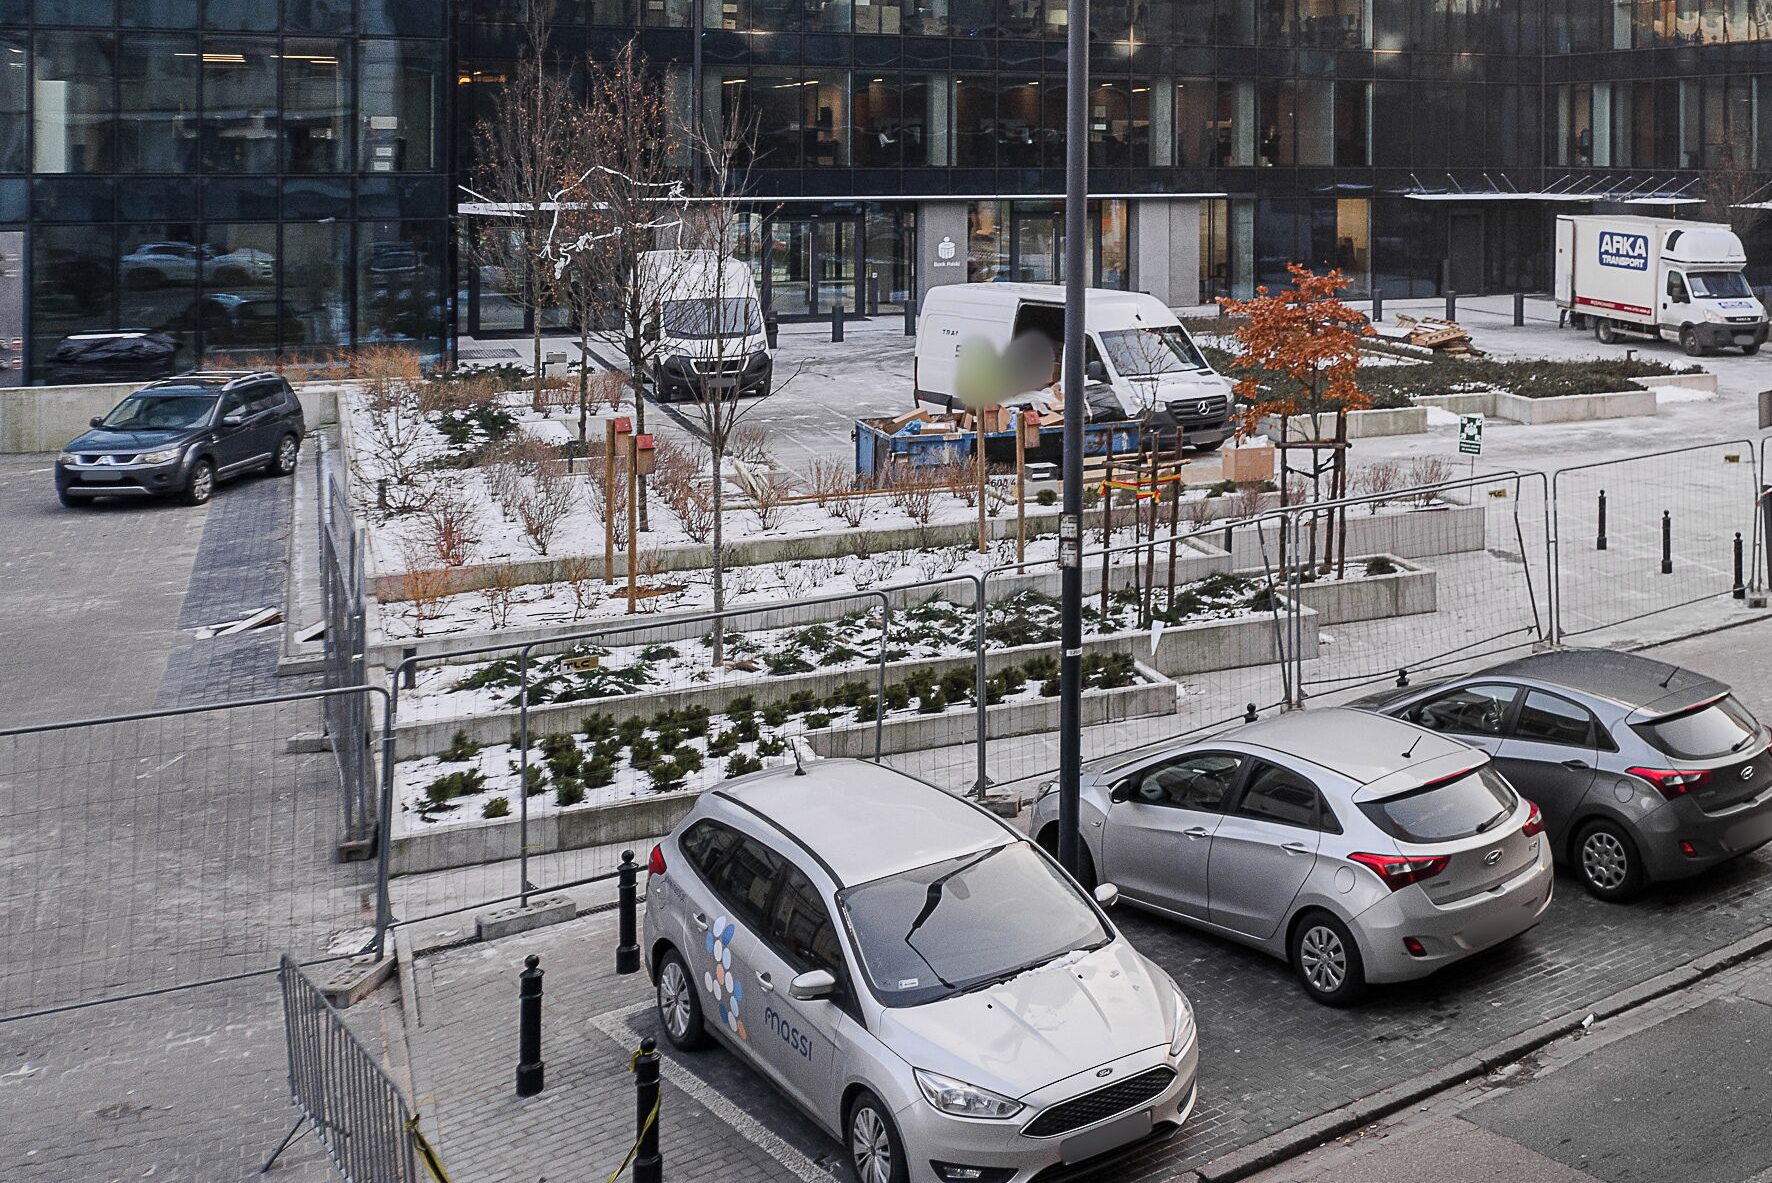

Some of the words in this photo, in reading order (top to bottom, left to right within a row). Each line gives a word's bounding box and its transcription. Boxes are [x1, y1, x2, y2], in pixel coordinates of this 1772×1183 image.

[1601, 234, 1647, 258] ARKA
[1602, 254, 1645, 268] TRANSPORT
[563, 660, 591, 670] TLC
